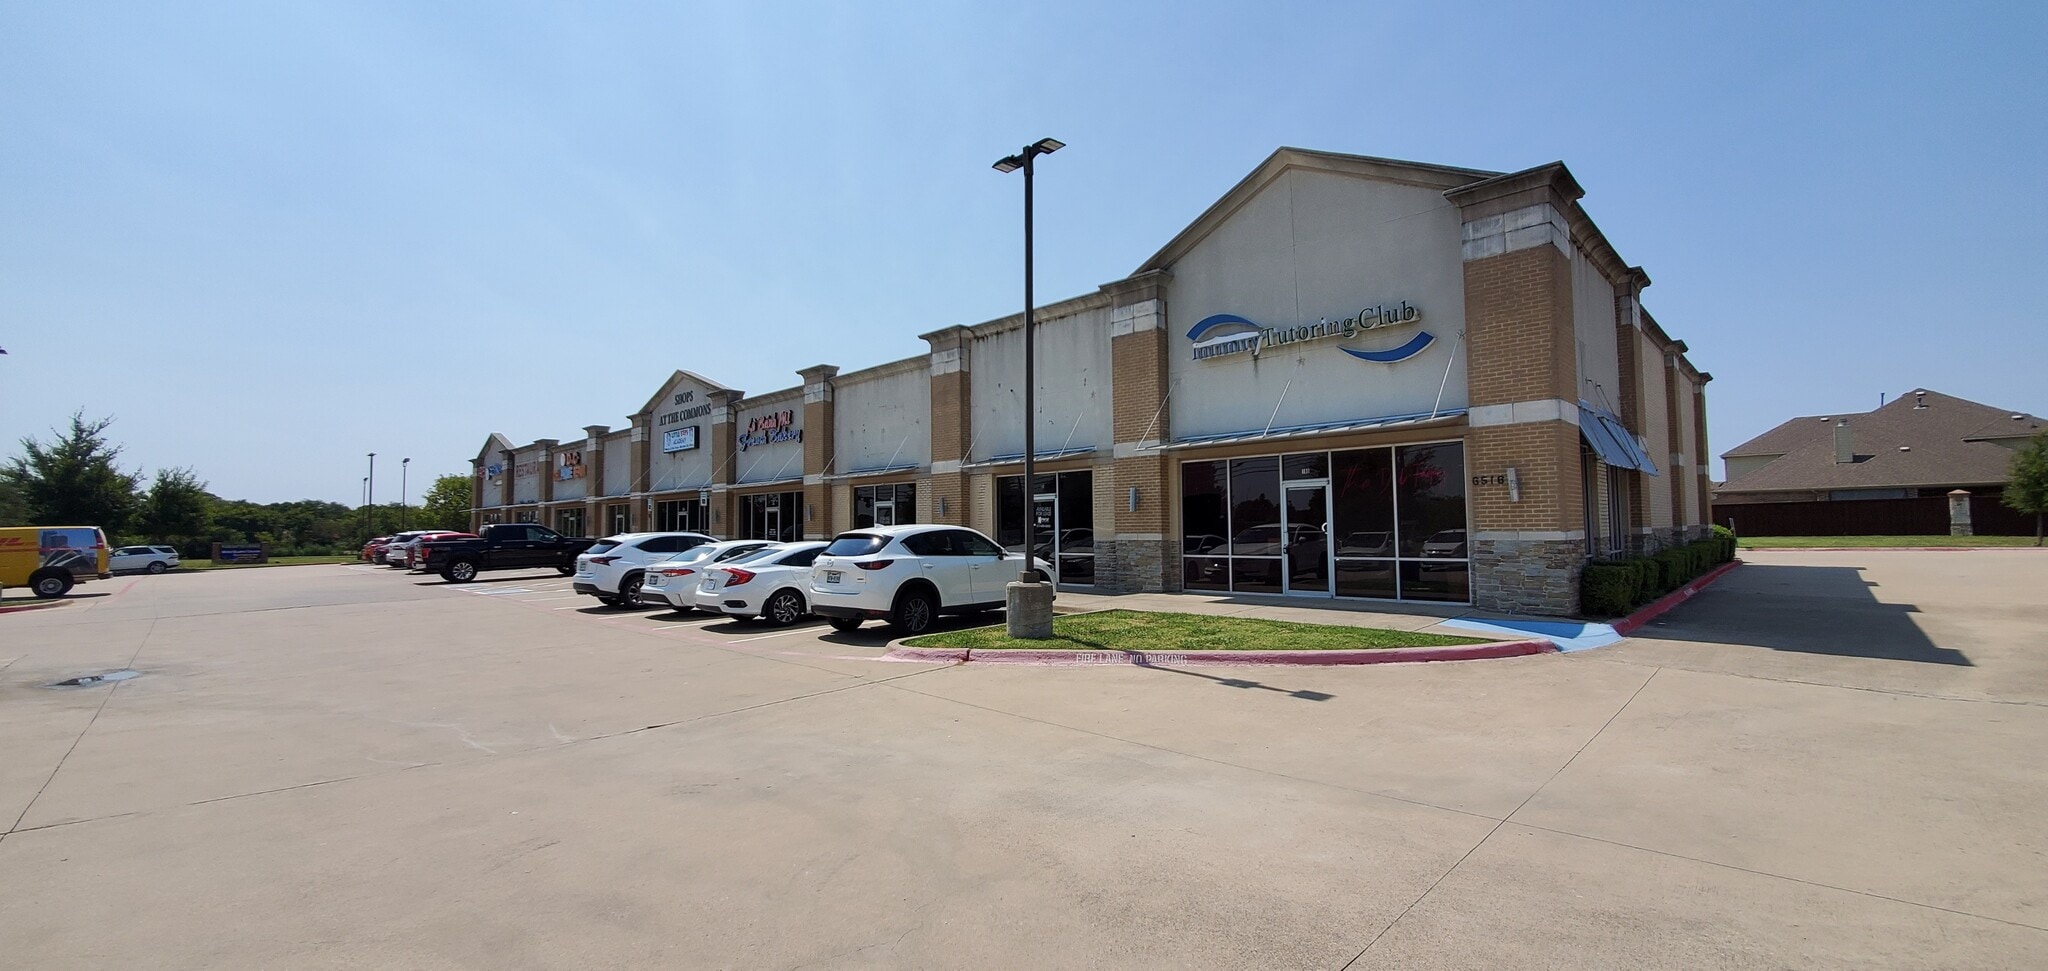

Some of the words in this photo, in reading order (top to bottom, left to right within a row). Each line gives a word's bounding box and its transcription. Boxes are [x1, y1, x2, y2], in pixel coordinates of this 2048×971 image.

[1261, 317, 1355, 347] Tutoring
[1358, 300, 1415, 329] Club
[674, 390, 694, 405] SHOPS
[658, 414, 667, 426] AT
[667, 411, 679, 424] THE
[679, 403, 711, 421] COMMONS
[1076, 653, 1097, 663] FIRE
[1099, 653, 1124, 664] LANE
[1129, 654, 1142, 664] NO
[1145, 654, 1188, 665] PARKING
